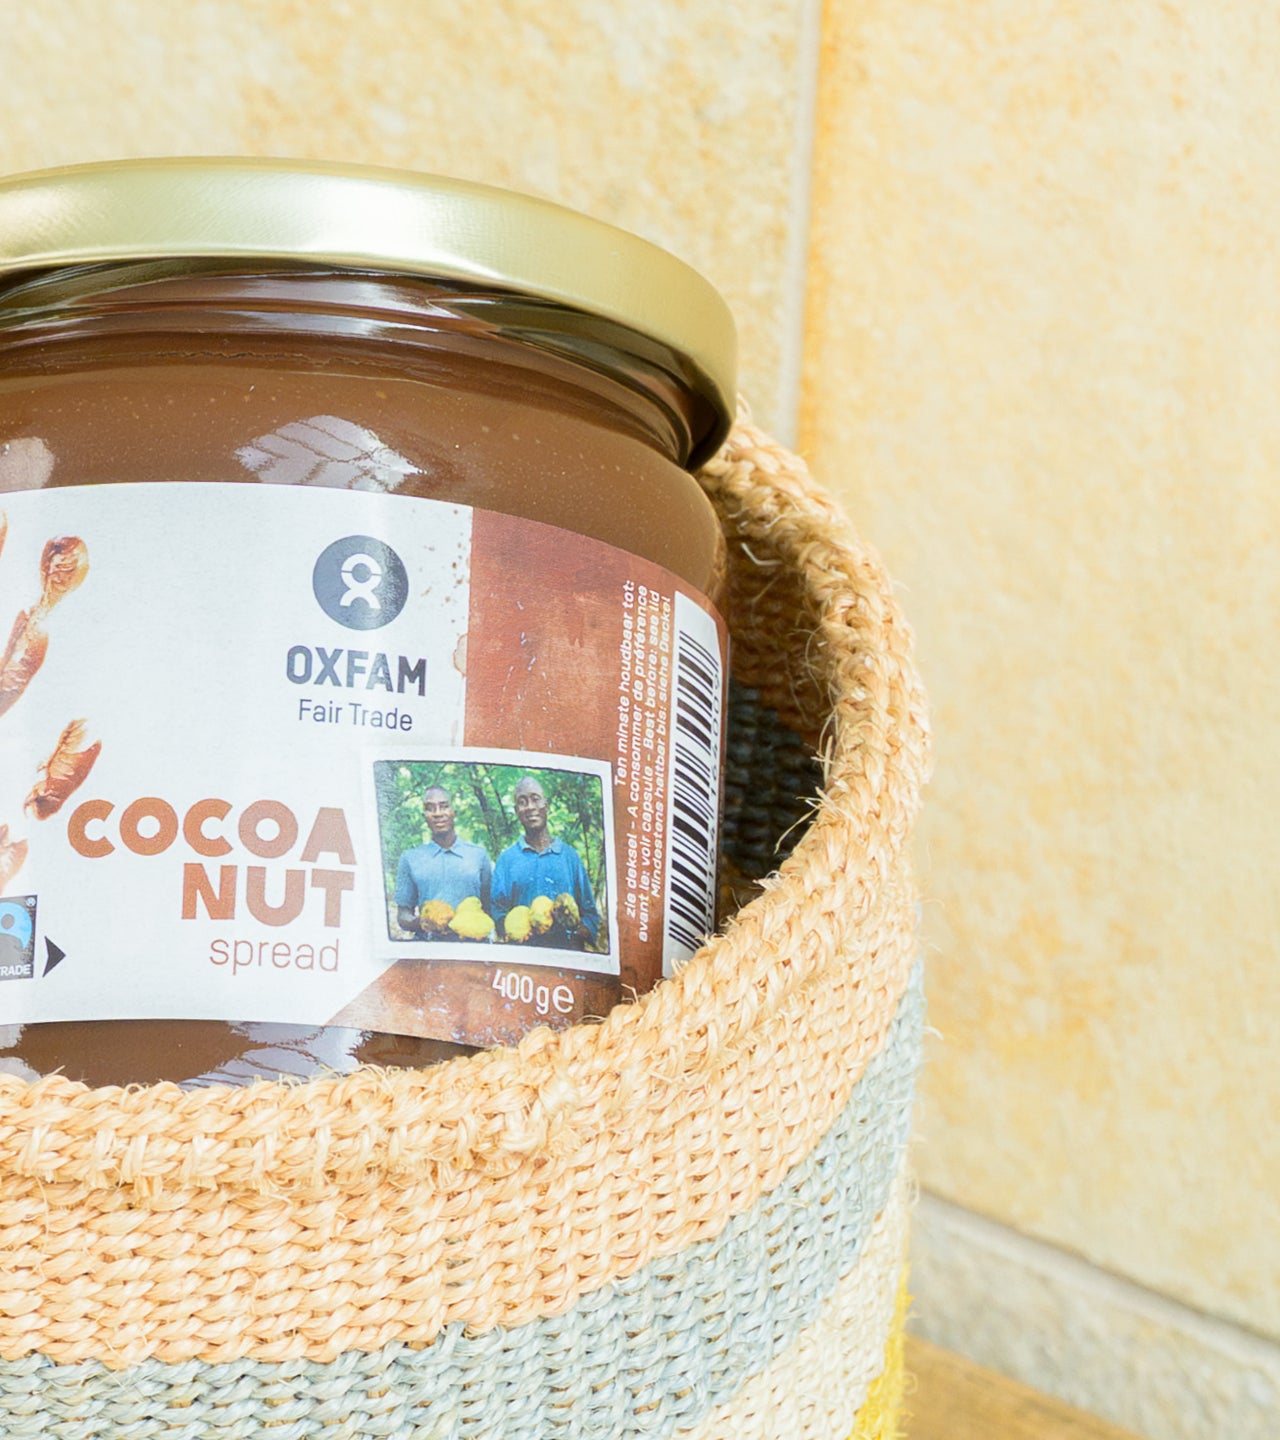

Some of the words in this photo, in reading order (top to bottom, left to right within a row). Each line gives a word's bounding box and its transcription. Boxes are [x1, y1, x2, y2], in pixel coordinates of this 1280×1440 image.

[623, 580, 635, 609] tot:
[649, 590, 660, 611] lid
[634, 585, 648, 678] préférence
[649, 615, 659, 646] see
[659, 596, 670, 652] Deckel
[286, 645, 427, 697] OXFAM
[619, 612, 634, 692] houdbaar
[633, 681, 643, 702] de
[645, 649, 658, 708] before:
[658, 655, 669, 703] siehe
[298, 699, 343, 725] Fair
[348, 703, 414, 732] Trade
[616, 696, 630, 756] minste
[643, 711, 656, 750] Best
[656, 706, 667, 735] bis:
[615, 756, 627, 786] Ten
[630, 704, 643, 803] consommer
[655, 738, 666, 798] haltbar
[627, 806, 639, 818] A
[642, 766, 655, 833] capsule
[67, 796, 358, 867] COCOA
[640, 835, 651, 866] voir
[651, 803, 664, 898] Mindestens
[626, 833, 638, 889] deksel
[639, 870, 650, 892] le:
[181, 862, 356, 929] NUT
[624, 891, 637, 919] zie
[638, 894, 649, 942] avant
[208, 940, 340, 976] spread
